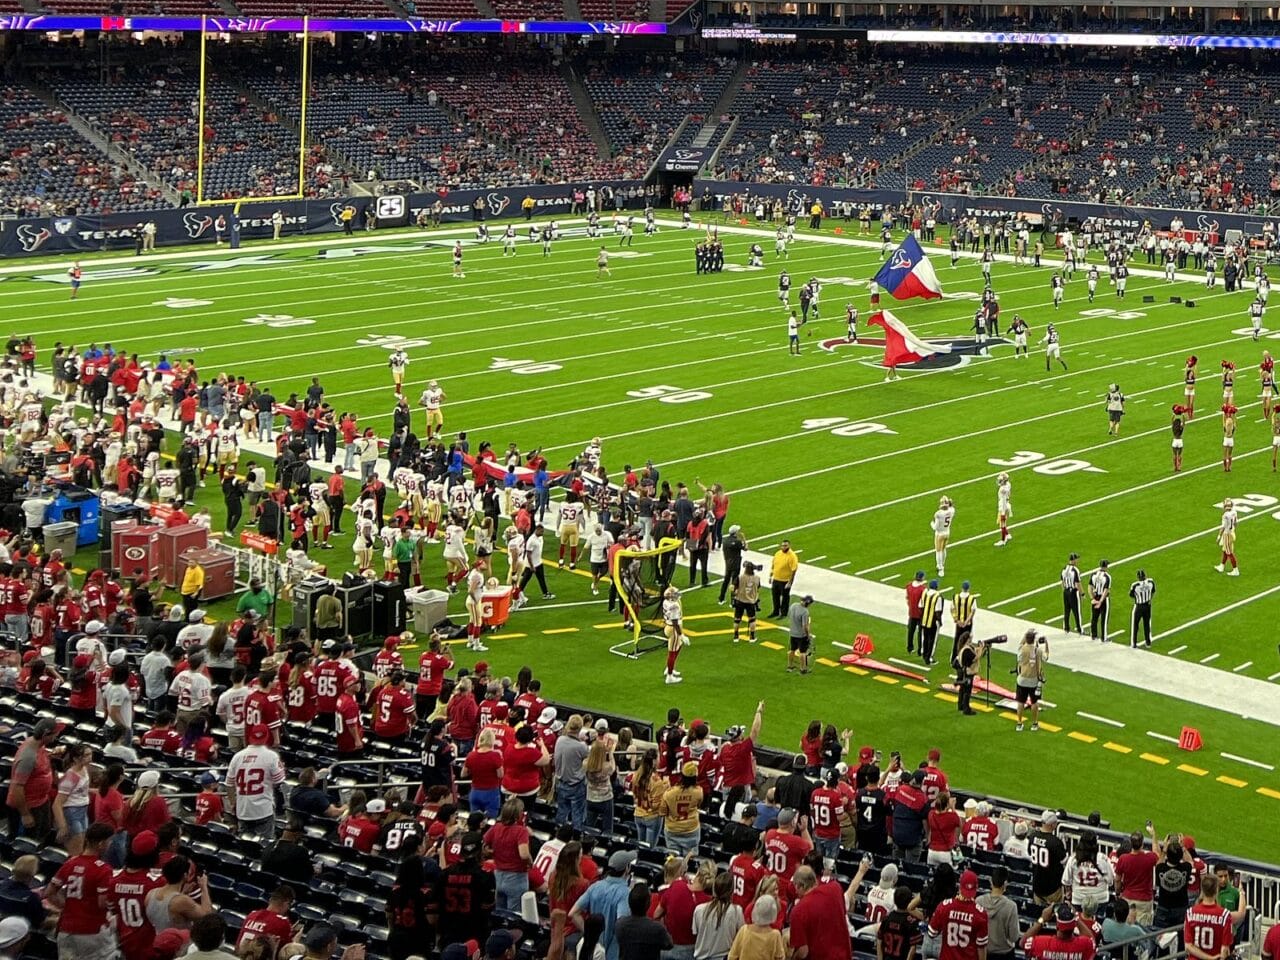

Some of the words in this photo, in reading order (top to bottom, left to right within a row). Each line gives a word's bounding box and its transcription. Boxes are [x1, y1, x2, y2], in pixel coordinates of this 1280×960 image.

[534, 197, 572, 206] EXAN
[966, 207, 1017, 218] TEXANS
[488, 356, 564, 375] 40
[625, 384, 714, 404] 50
[28, 410, 39, 421] 82
[800, 416, 888, 437] 40
[987, 450, 1092, 475] 30
[562, 508, 577, 521] 53
[944, 516, 950, 527] 5
[482, 602, 493, 618] G
[853, 637, 866, 652] 20
[317, 676, 338, 698] 85
[231, 703, 244, 725] 5
[380, 701, 390, 723] 5
[1183, 731, 1194, 746] 10
[242, 754, 258, 764] LOTT
[421, 750, 436, 768] 80
[235, 768, 265, 796] 42
[675, 793, 692, 803] LANCE
[676, 803, 689, 821] 5
[813, 805, 831, 827] 19
[863, 805, 873, 822] 4
[394, 822, 414, 831] RICE
[970, 823, 988, 832] KITTLE
[1033, 835, 1047, 845] RICE
[1030, 845, 1049, 868] 80
[1077, 871, 1099, 887] 15
[871, 889, 888, 901] RICE
[118, 897, 144, 928] 10
[949, 910, 974, 923] KITTLE
[244, 920, 266, 933] LANCE
[946, 922, 971, 948] 85
[1194, 926, 1215, 949] 10
[884, 933, 904, 957] 97
